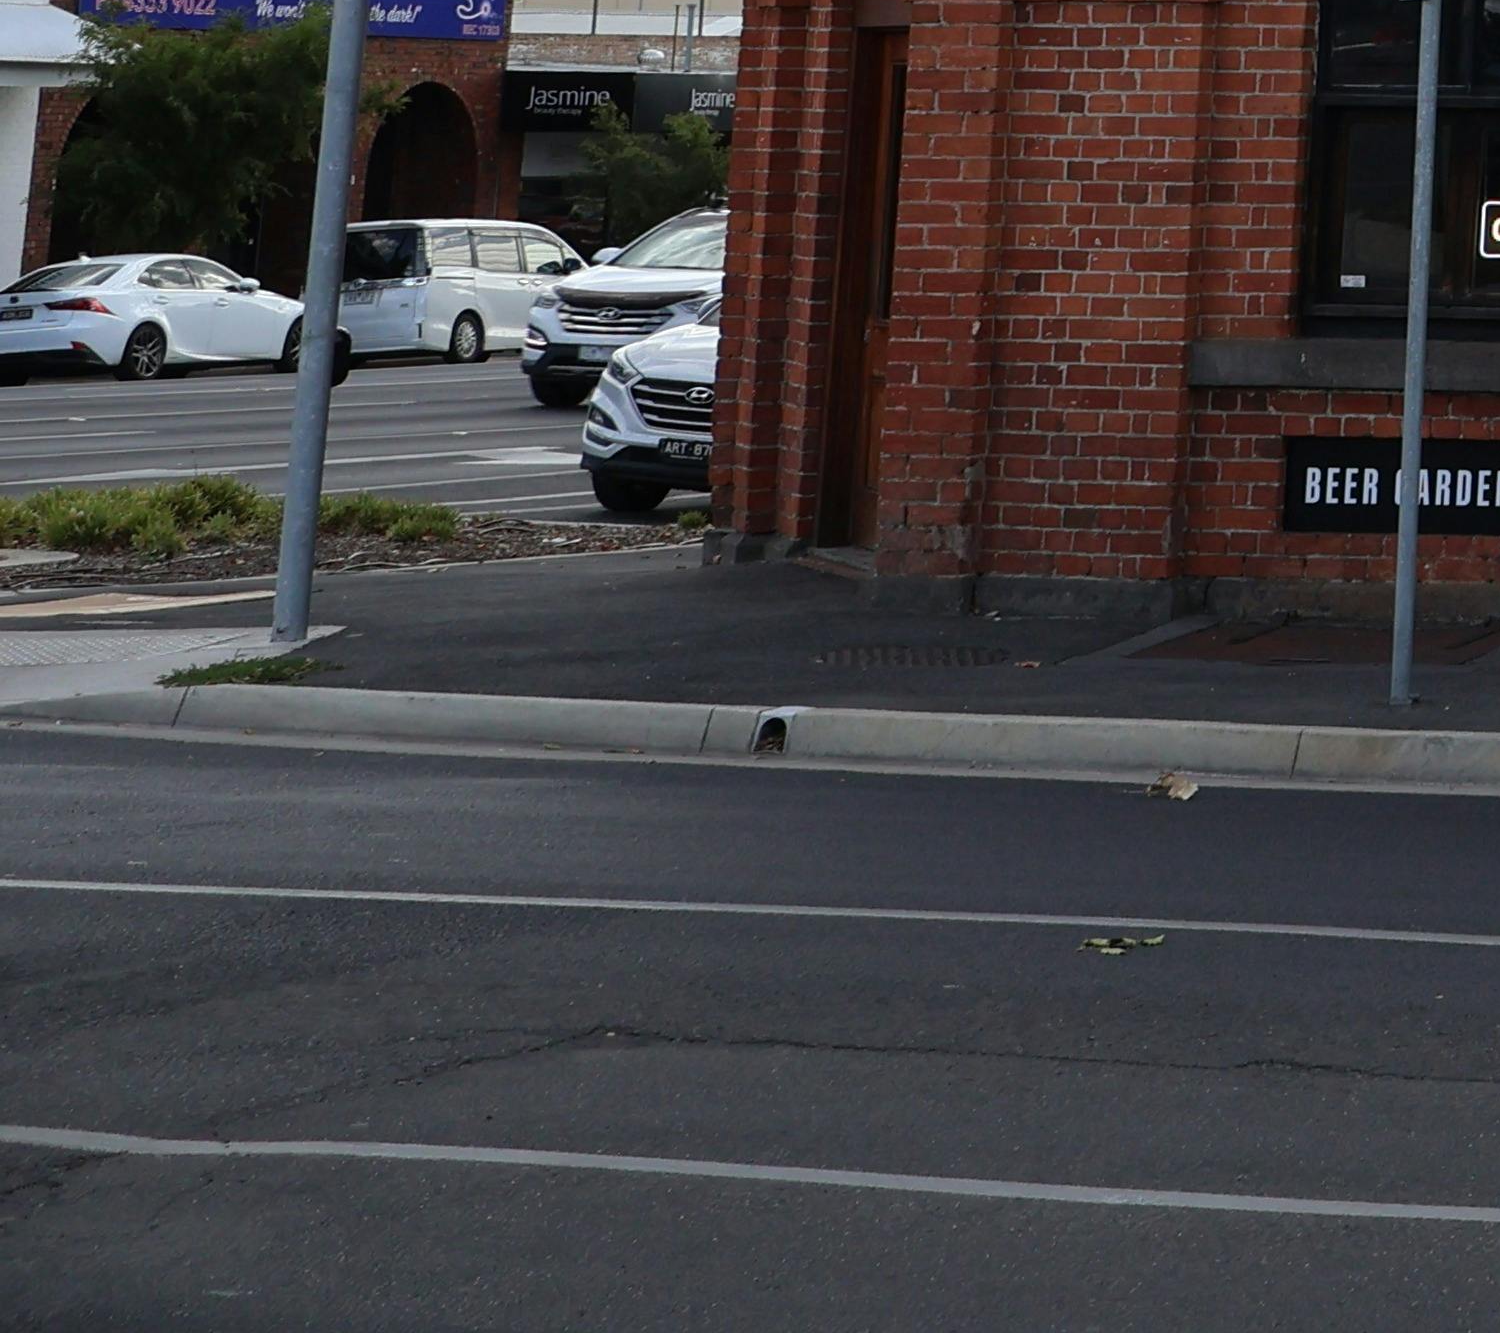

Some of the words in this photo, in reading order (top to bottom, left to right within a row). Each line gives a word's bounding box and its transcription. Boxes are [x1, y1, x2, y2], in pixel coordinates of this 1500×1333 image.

[526, 86, 611, 110] Jasmine
[688, 87, 736, 112] Jasmine
[1304, 466, 1379, 506] BEER
